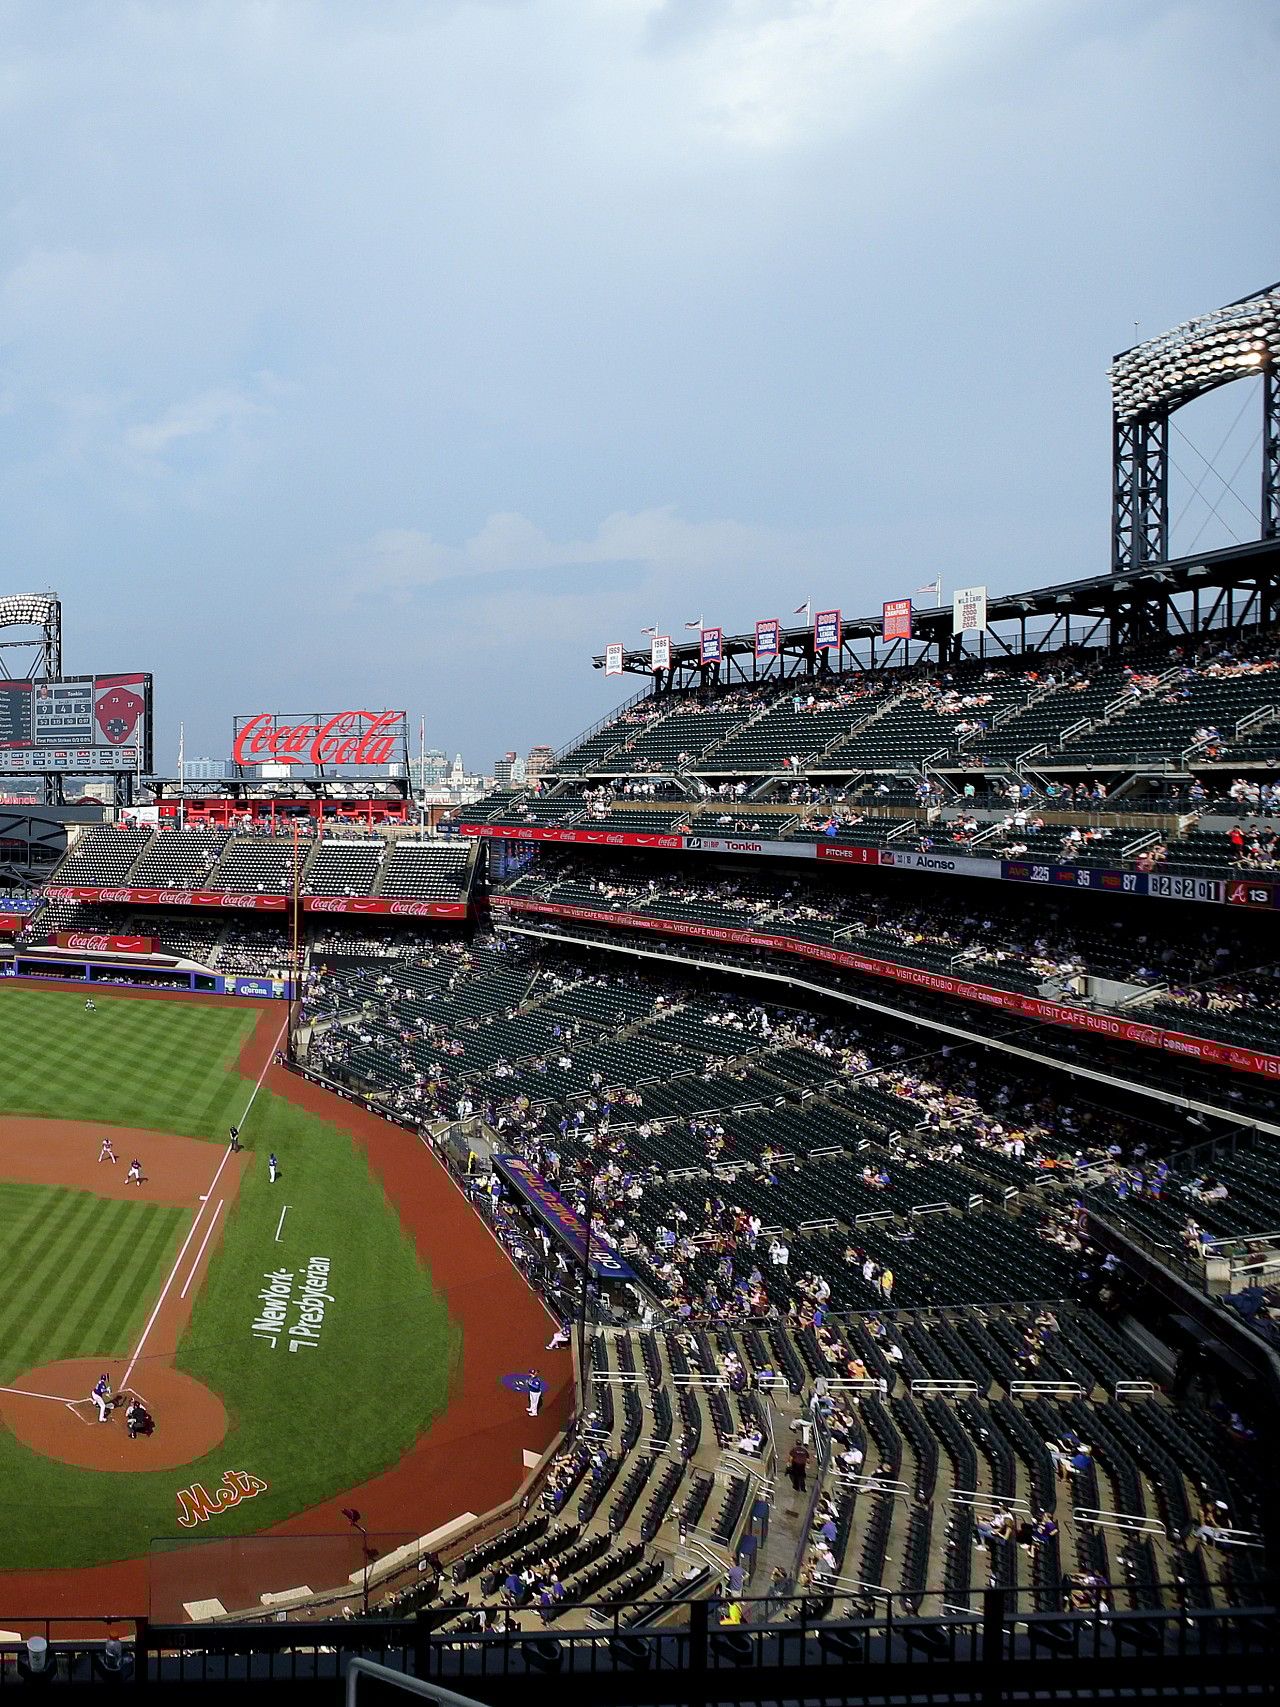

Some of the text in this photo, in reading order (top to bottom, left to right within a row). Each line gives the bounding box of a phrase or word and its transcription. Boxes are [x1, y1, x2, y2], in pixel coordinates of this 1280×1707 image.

[42, 704, 86, 714] 9 4 5
[233, 710, 407, 766] Coca-Cola
[724, 840, 762, 852] Tonkin
[825, 848, 867, 862] PITCHES 9
[916, 856, 956, 870] Alonso
[1030, 866, 1050, 882] .225
[1077, 869, 1090, 886] 35
[1122, 874, 1137, 891] 87
[99, 889, 133, 902] Coca-Cola
[1152, 877, 1215, 900] B 2 S 2 1
[1249, 889, 1268, 902] 13
[220, 894, 257, 908] Coca-Cola
[310, 897, 348, 911] Coca-Cola
[390, 901, 430, 915] Coca-Cola
[67, 934, 110, 950] Coca-Cola
[6, 969, 15, 977] 370
[240, 985, 268, 995] Corona
[1036, 1004, 1060, 1019] VISIT
[1086, 1016, 1119, 1033] RUBIO
[1163, 1038, 1201, 1056] CORNER
[288, 1256, 335, 1338] Presbyterian
[176, 1470, 269, 1529] Mets
